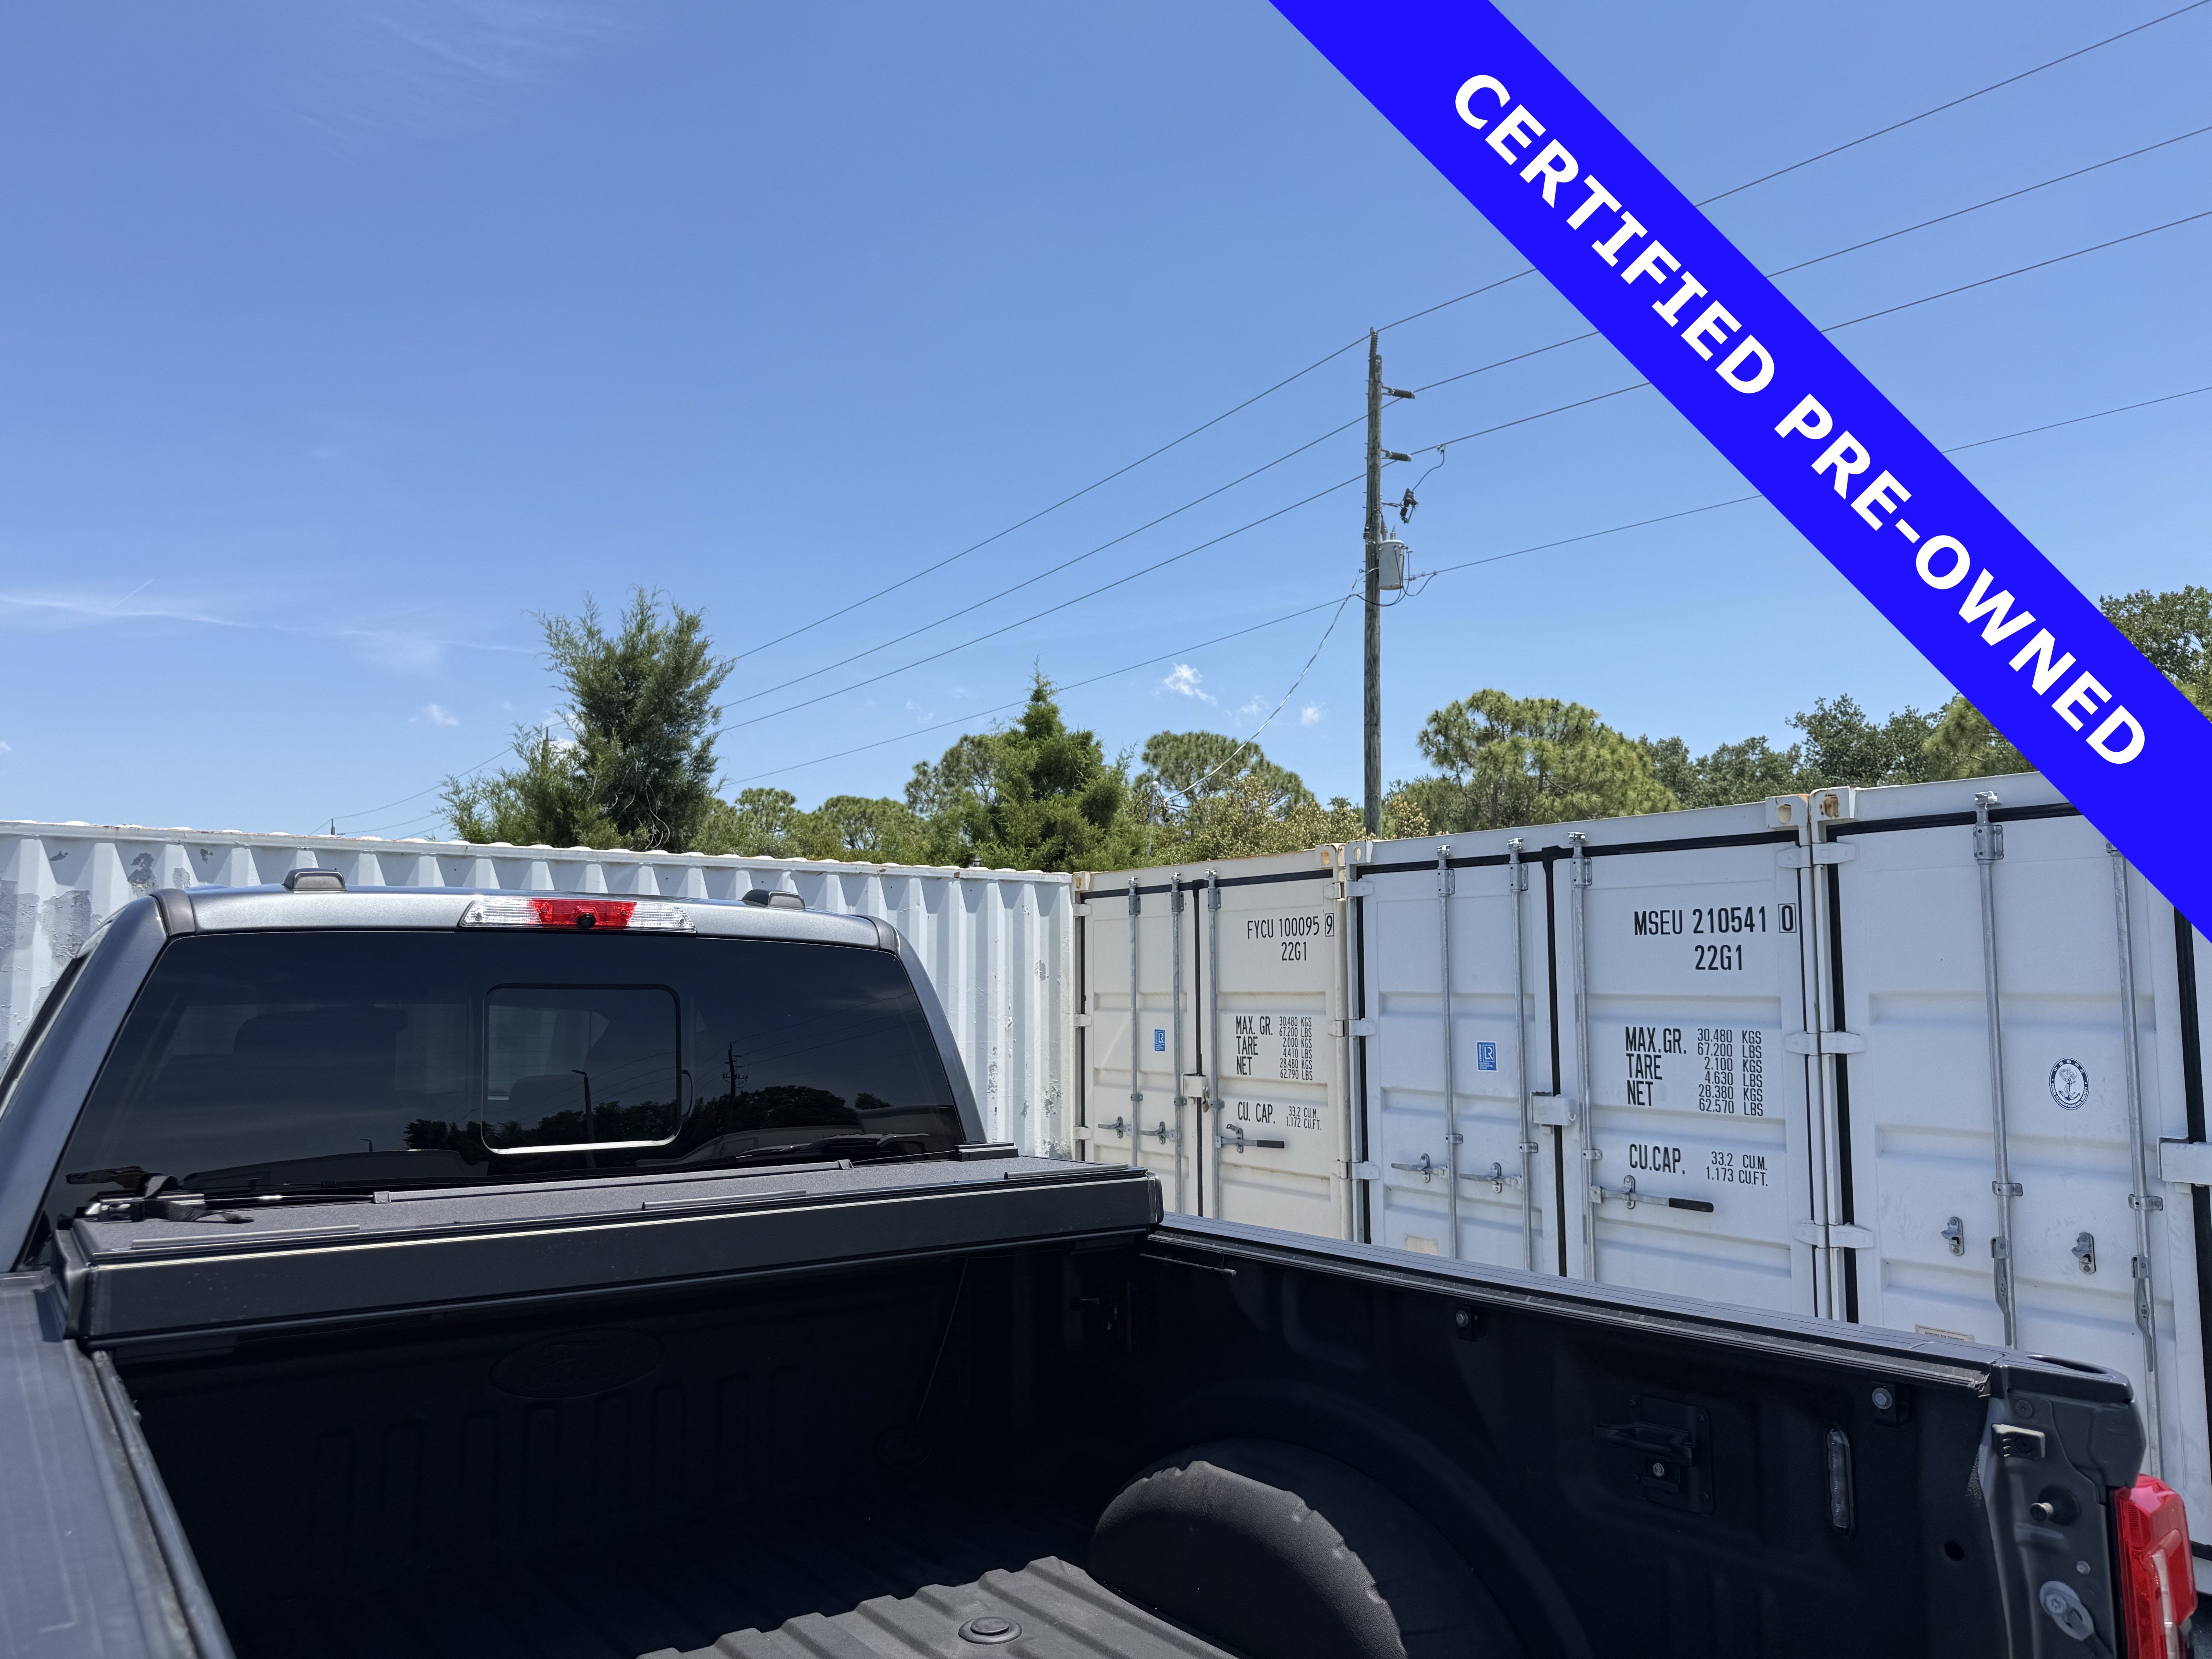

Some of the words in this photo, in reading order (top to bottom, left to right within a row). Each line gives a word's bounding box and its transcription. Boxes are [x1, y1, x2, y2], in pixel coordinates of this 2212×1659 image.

[1247, 919, 1273, 939] FYCU
[1279, 916, 1319, 937] 100095
[1326, 915, 1333, 934] 9
[1634, 909, 1683, 936] MSEU
[1692, 906, 1766, 934] 210541
[1781, 905, 1793, 931] 0
[1281, 941, 1307, 961] 22G1
[1695, 944, 1742, 970] 22G1
[1236, 1016, 1255, 1035] MAX.
[1259, 1016, 1273, 1036] GR.
[1279, 1016, 1298, 1027] 30.480
[1301, 1017, 1312, 1027] KGS
[1279, 1027, 1298, 1037] 67.200
[1301, 1027, 1312, 1037] LBS
[1159, 1033, 1164, 1043] LR
[1236, 1036, 1259, 1055] TARE
[1283, 1037, 1298, 1048] 2.000
[1301, 1038, 1312, 1048] KGS
[1697, 1028, 1732, 1043] 30.480
[1742, 1030, 1762, 1044] KGS
[1302, 1049, 1312, 1059] LBS
[1484, 1046, 1493, 1060] LR
[1697, 1042, 1733, 1057] 67.200
[1743, 1045, 1762, 1059] LBS
[1237, 1056, 1252, 1075] NET
[1280, 1058, 1298, 1069] 28.480
[1302, 1059, 1312, 1070] KGS
[1280, 1069, 1298, 1079] 62.790
[1302, 1070, 1312, 1080] LBS
[1626, 1053, 1662, 1080] TARE
[1704, 1057, 1733, 1072] 2.100
[1743, 1059, 1762, 1073] KGS
[1705, 1070, 1733, 1085] 4.630
[1743, 1073, 1763, 1087] LBS
[1626, 1080, 1653, 1106] NET
[1698, 1084, 1734, 1100] 28.380
[1743, 1087, 1763, 1102] KGS
[1238, 1101, 1250, 1121] CU.
[1255, 1103, 1275, 1124] CAP.
[1288, 1106, 1301, 1117] 33.2
[1699, 1098, 1734, 1114] 62.570
[1744, 1102, 1763, 1116] LBS
[1286, 1116, 1301, 1128] 1.172
[1304, 1118, 1322, 1130] CU.FT.
[1711, 1151, 1733, 1167] 33.2
[1743, 1154, 1767, 1171] CU.M.
[1706, 1166, 1733, 1182] 1.173
[1739, 1170, 1768, 1187] CU.FT.
